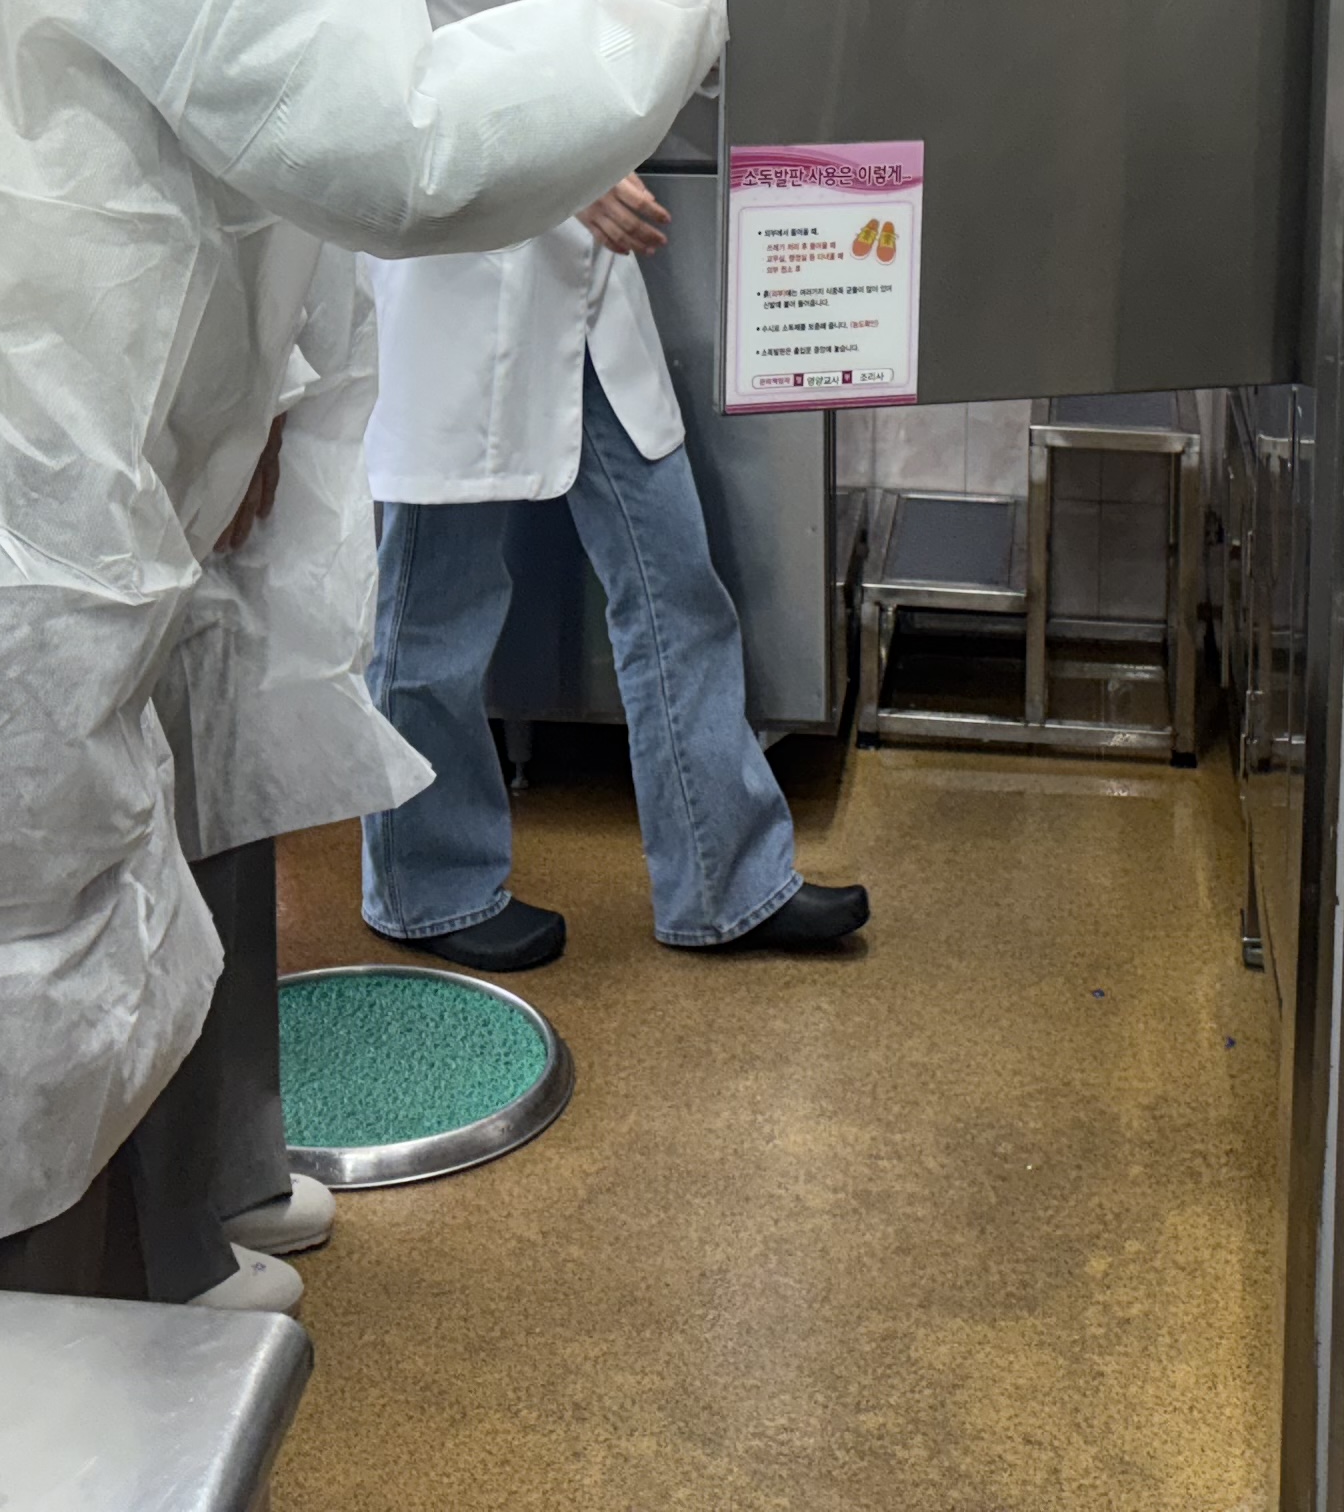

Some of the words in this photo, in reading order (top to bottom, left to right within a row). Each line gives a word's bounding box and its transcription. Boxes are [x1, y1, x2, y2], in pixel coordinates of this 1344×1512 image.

[743, 167, 804, 188] 소독발판
[808, 166, 852, 187] 사용은
[807, 375, 840, 387] 영양교사
[860, 372, 885, 382] 조리사
